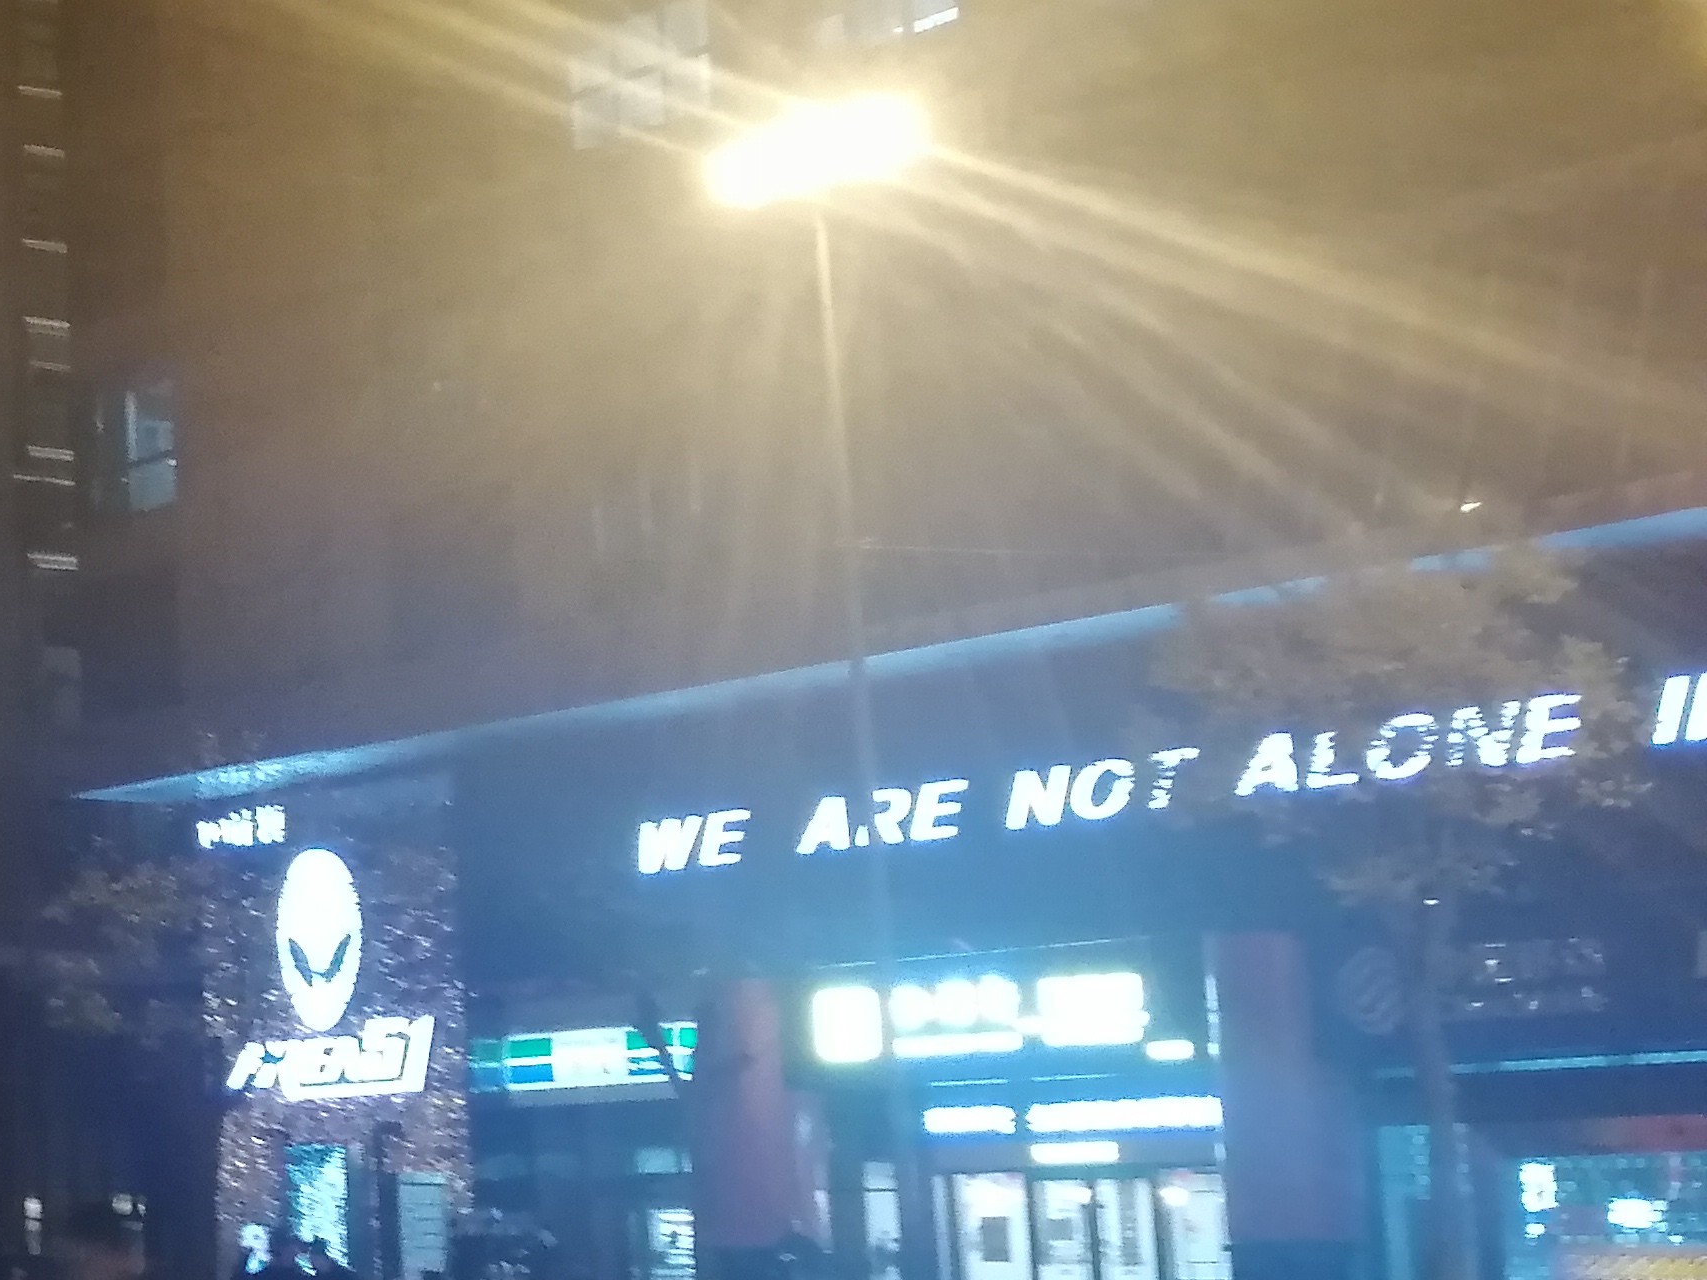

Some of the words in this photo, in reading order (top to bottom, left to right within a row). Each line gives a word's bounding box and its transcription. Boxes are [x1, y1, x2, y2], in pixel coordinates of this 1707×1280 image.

[637, 808, 752, 875] WE
[795, 778, 970, 855] ARE
[1004, 747, 1200, 830] NOT
[1234, 692, 1583, 797] ALONE
